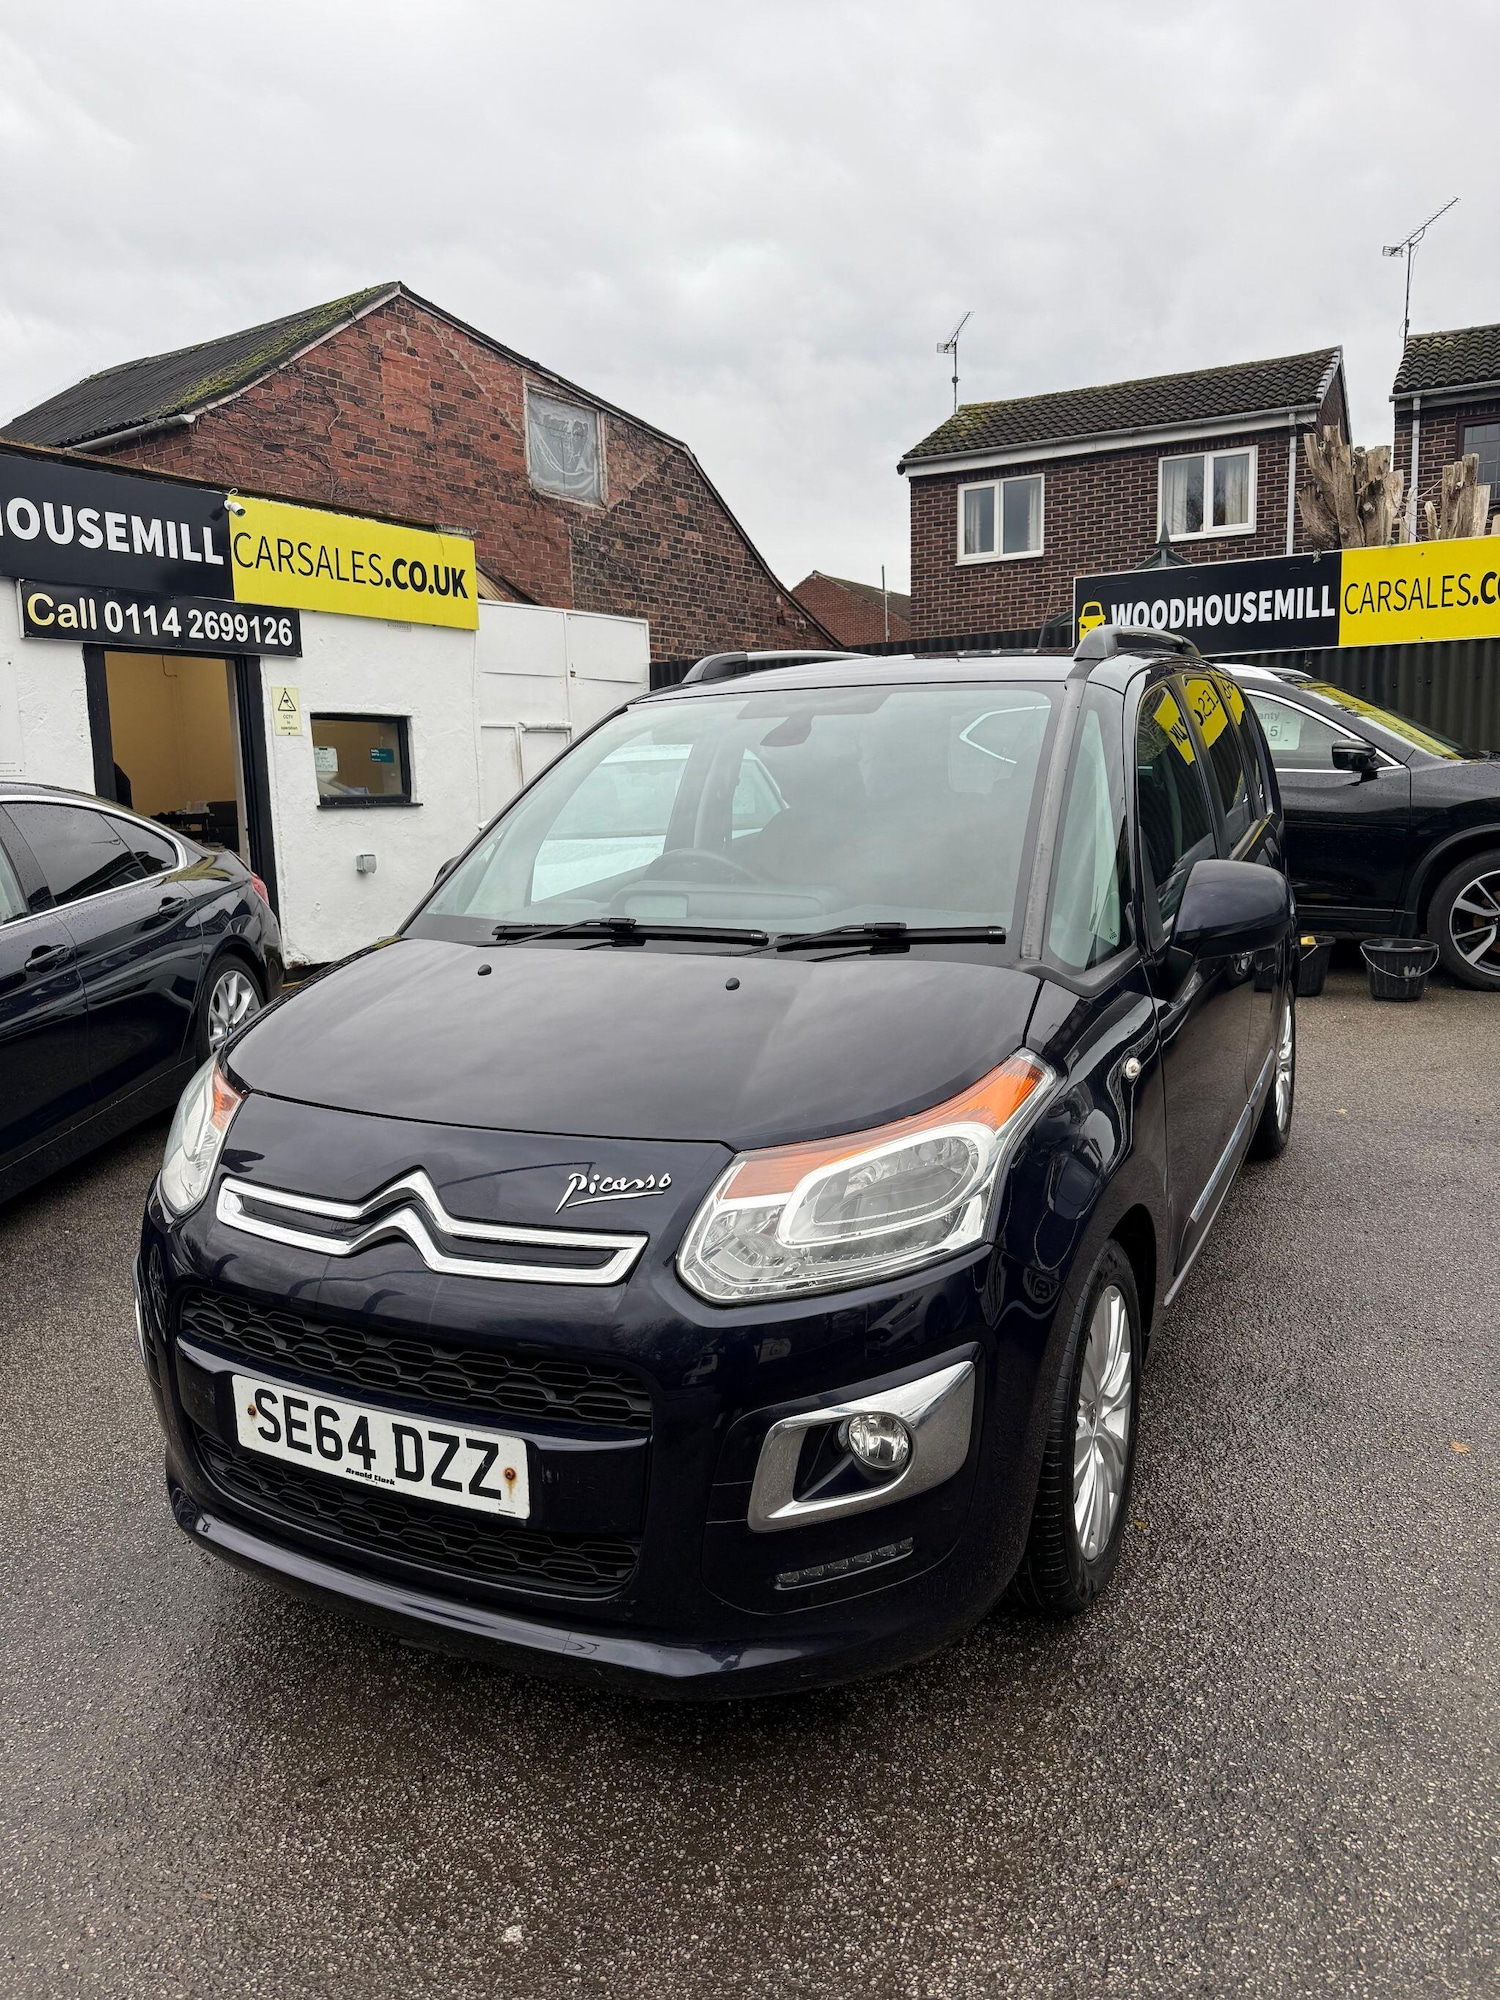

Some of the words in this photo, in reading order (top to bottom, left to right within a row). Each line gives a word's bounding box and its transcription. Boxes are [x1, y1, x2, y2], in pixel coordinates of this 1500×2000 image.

[0, 497, 224, 565] OUSEMILL
[233, 532, 469, 599] CARSALES.CO.UK
[27, 592, 98, 630] Call
[104, 601, 182, 637] 0114
[187, 609, 293, 646] 2699126
[1111, 585, 1335, 629] WOODHOUSEMILL
[1344, 571, 1500, 615] CARSALES.C
[555, 1172, 672, 1214] Picasso
[254, 1388, 377, 1471] SE64
[391, 1422, 502, 1500] DZZ
[345, 1467, 372, 1479] Arnold
[374, 1474, 396, 1486] Clark
